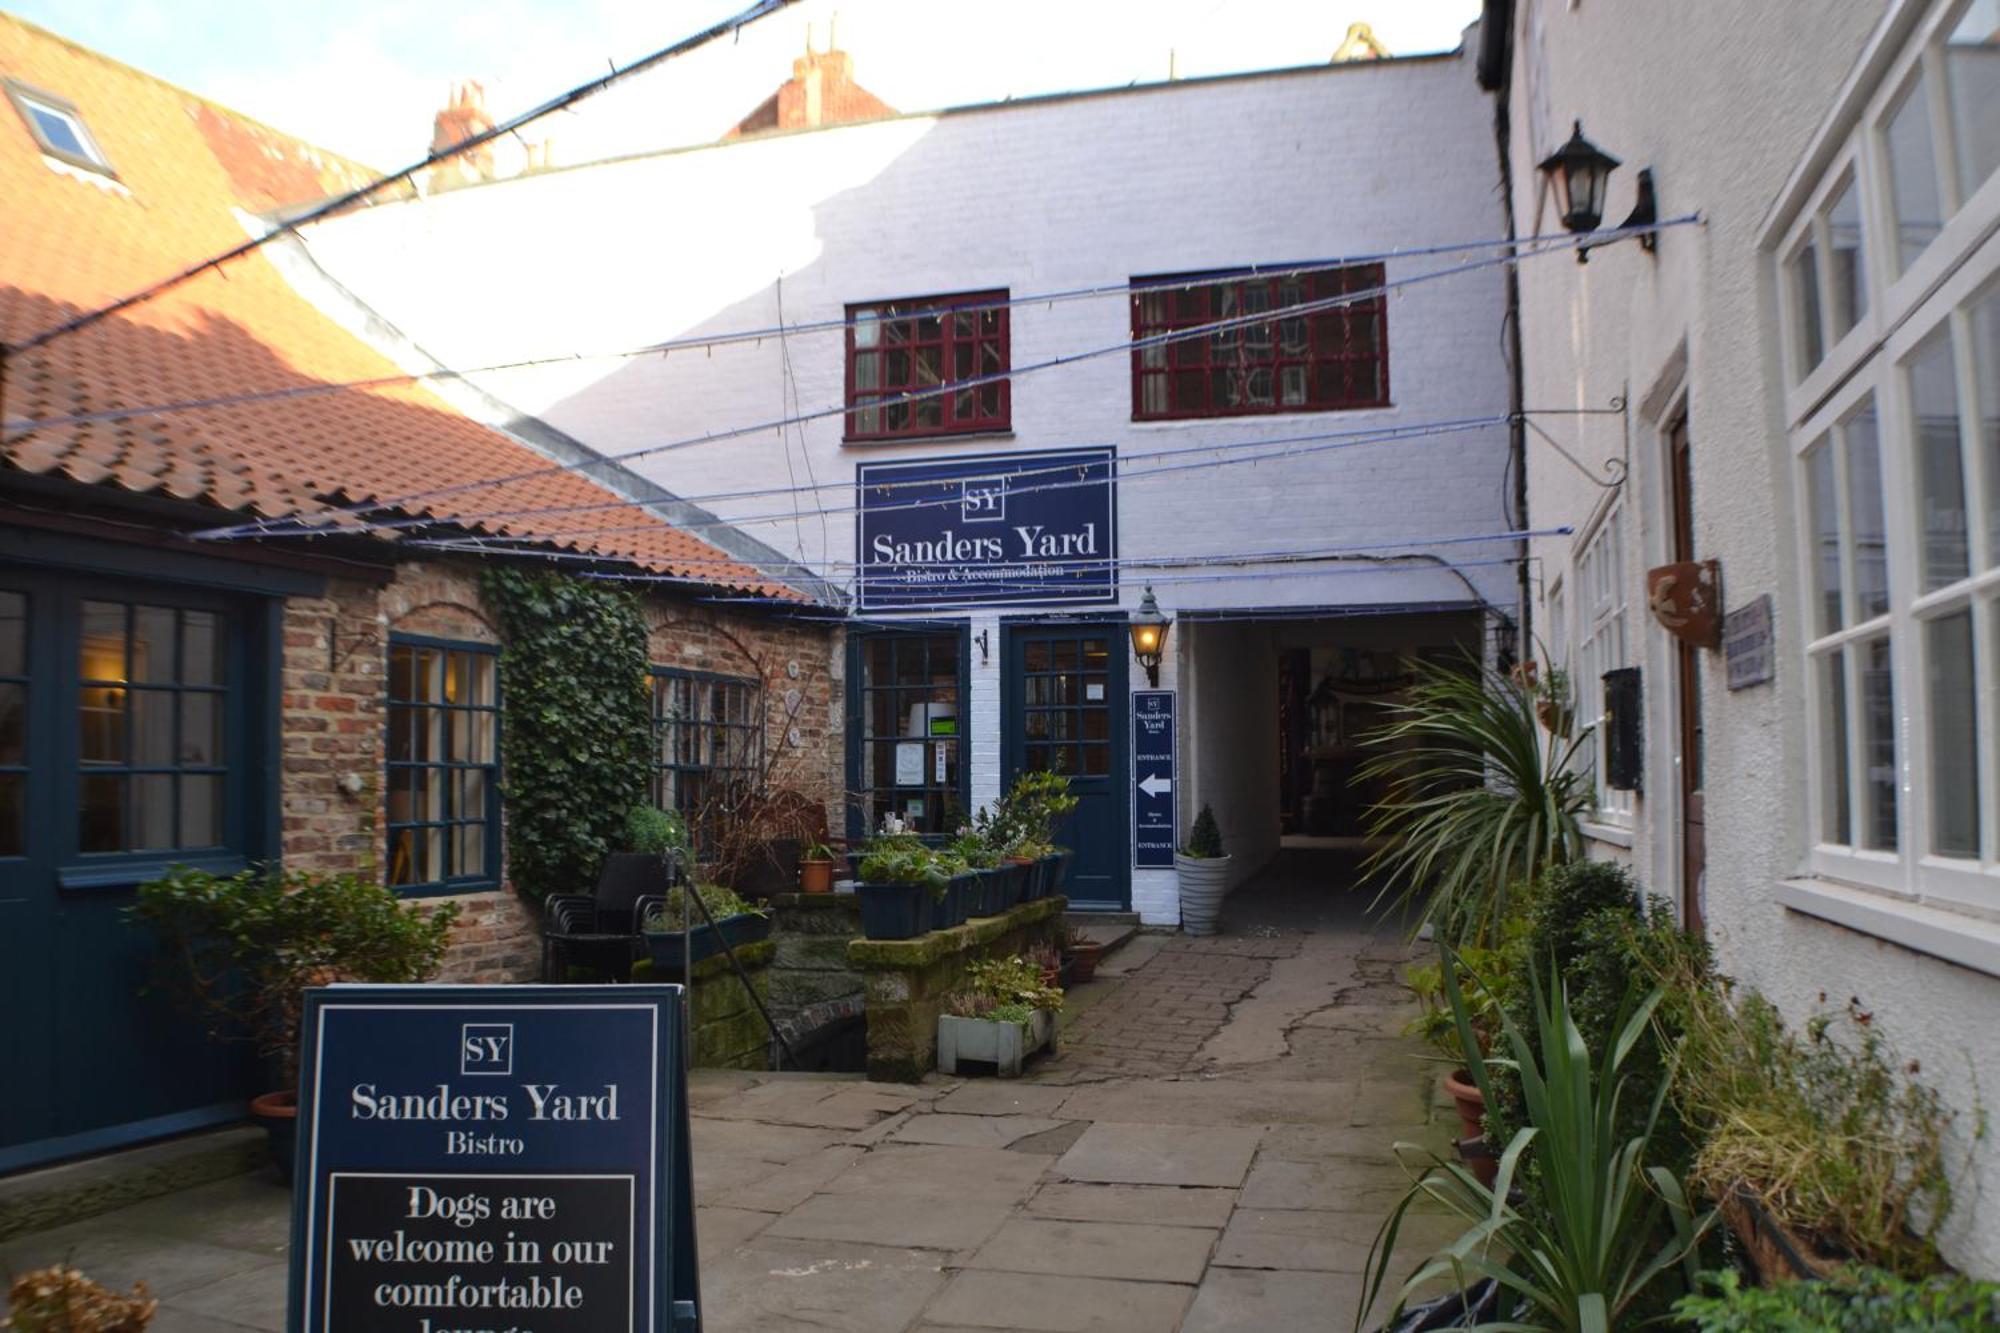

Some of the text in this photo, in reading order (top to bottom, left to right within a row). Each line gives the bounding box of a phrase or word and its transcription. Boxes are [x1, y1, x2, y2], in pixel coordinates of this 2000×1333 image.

[966, 488, 998, 511] SY
[873, 523, 1099, 565] Sanders Yard
[906, 564, 1064, 583] Bistro & Accommodation
[1136, 711, 1172, 720] Sanders
[1144, 720, 1165, 730] Yard
[465, 1036, 508, 1062] SY
[352, 1083, 621, 1121] Sanders Yard
[446, 1130, 524, 1156] Bistro
[404, 1186, 556, 1228] Dogs are
[348, 1231, 614, 1265] welcome in our
[374, 1275, 584, 1308] comfortable
